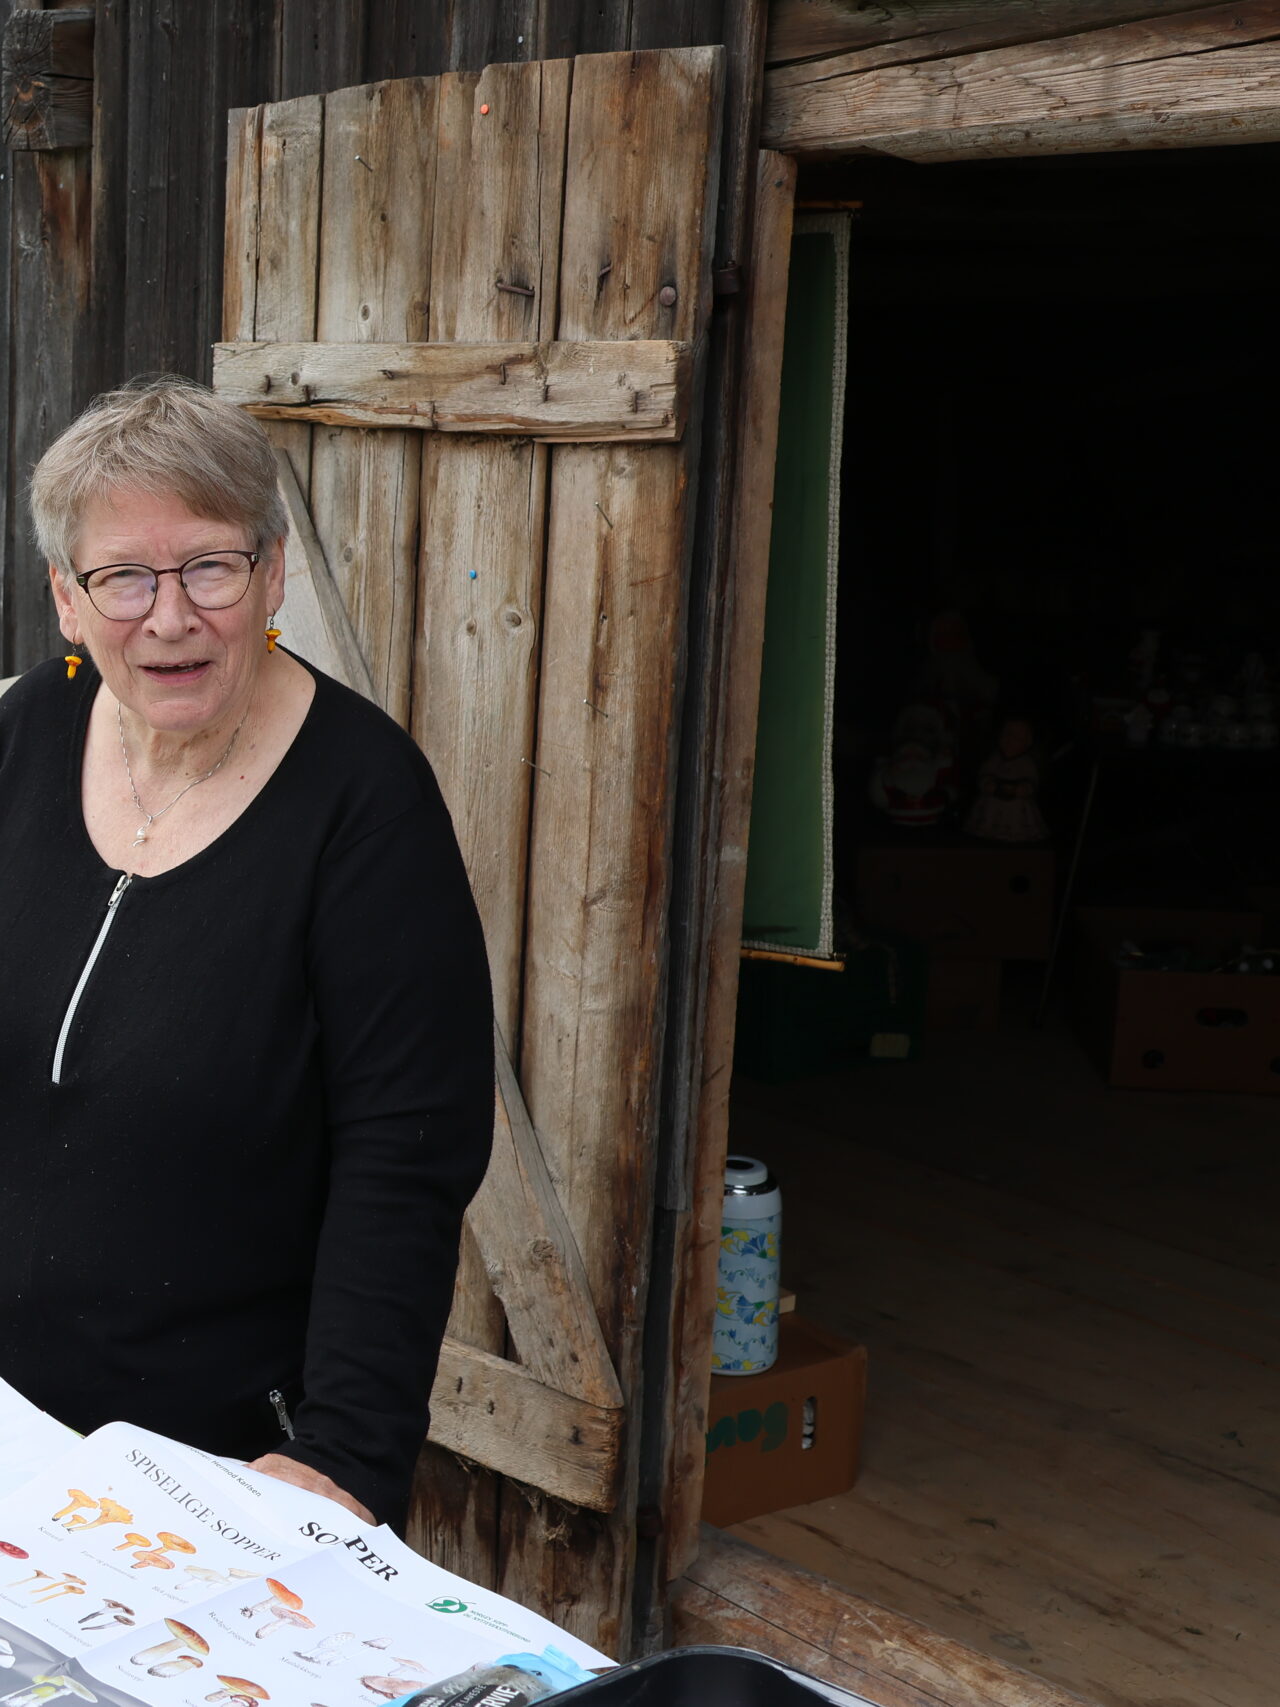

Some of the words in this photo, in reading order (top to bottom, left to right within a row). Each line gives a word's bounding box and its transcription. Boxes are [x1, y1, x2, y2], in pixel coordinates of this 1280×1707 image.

[124, 1448, 214, 1523] SPISELIGE
[210, 1518, 282, 1562] SOPPER
[212, 1459, 238, 1479] Hermod
[236, 1477, 261, 1497] Karlsen
[298, 1521, 399, 1584] SOPER
